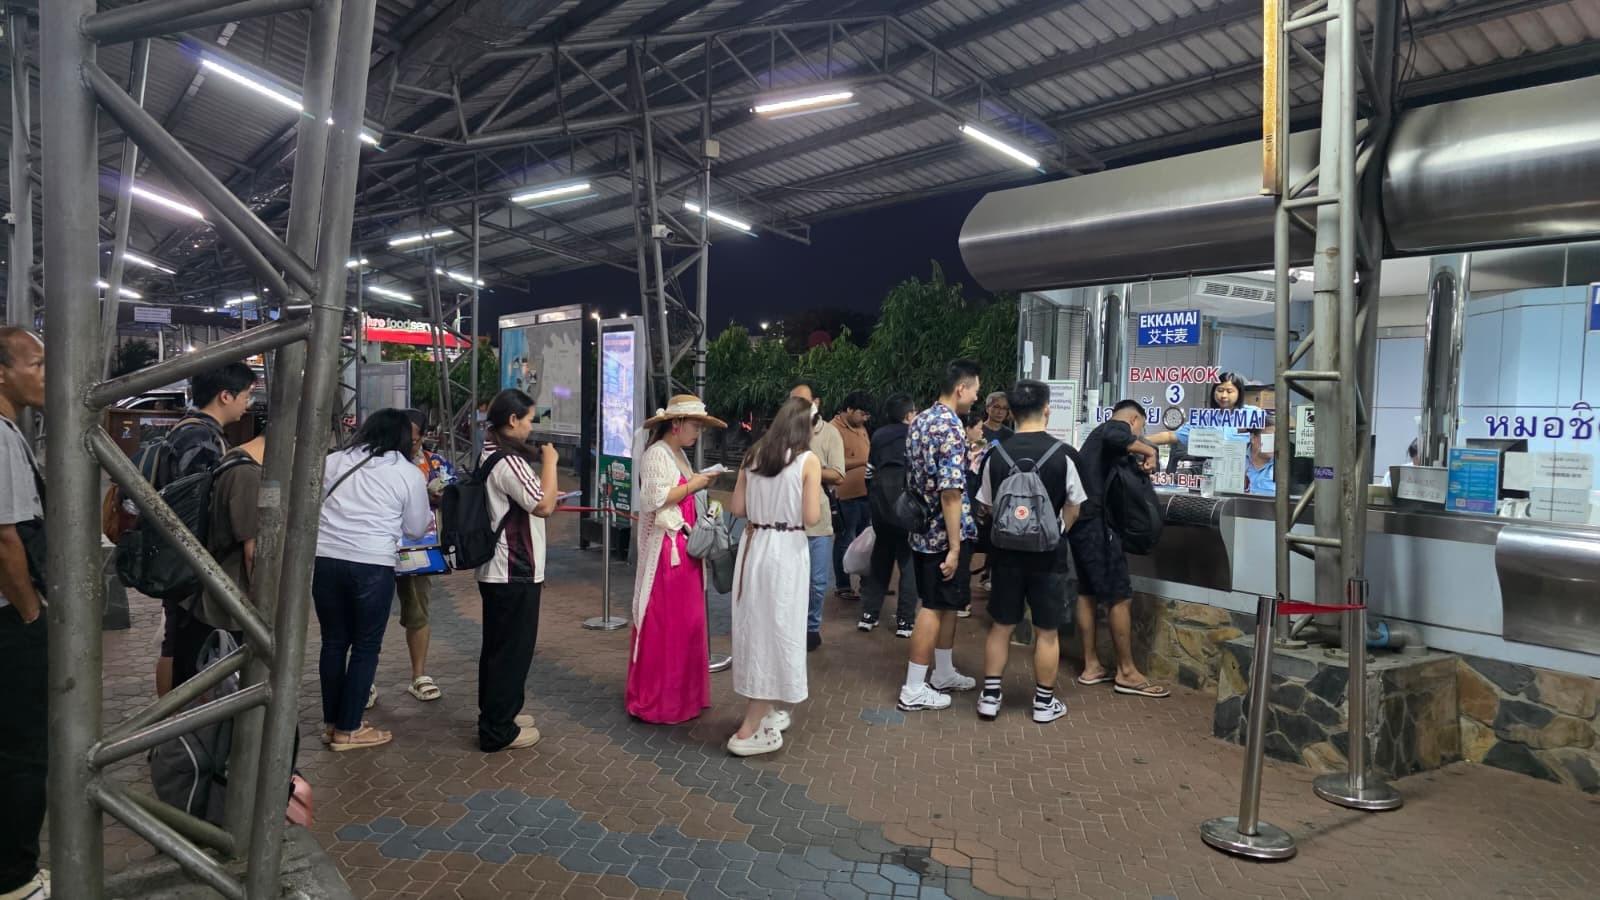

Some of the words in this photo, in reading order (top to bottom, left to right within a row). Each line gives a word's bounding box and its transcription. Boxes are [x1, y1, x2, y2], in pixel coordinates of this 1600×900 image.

[1140, 312, 1198, 329] EKKAMAI
[1147, 328, 1189, 345] 艾卡麦
[1129, 366, 1222, 383] BANGKOK
[1169, 385, 1180, 403] 3
[1189, 409, 1265, 429] EKKAMAI
[1485, 401, 1600, 439] หมอชิ
